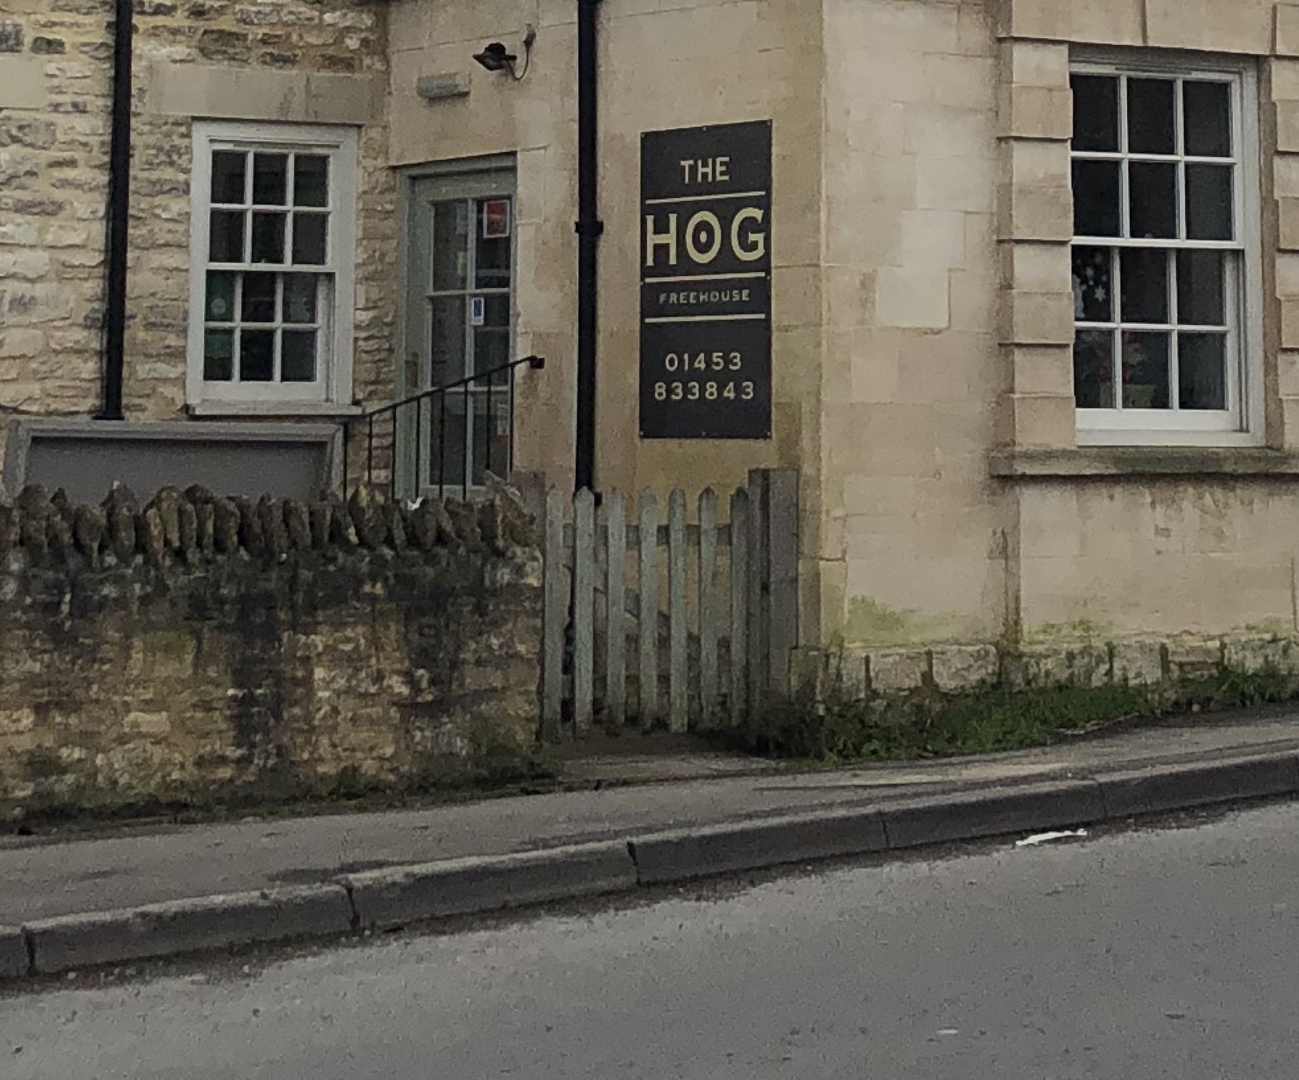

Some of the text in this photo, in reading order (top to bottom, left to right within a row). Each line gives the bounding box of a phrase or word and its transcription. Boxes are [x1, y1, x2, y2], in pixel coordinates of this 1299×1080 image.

[679, 156, 731, 185] THE
[644, 206, 767, 267] HOG
[658, 288, 751, 305] FREEHOUSE
[664, 351, 743, 372] 01453
[653, 380, 755, 401] 833843
